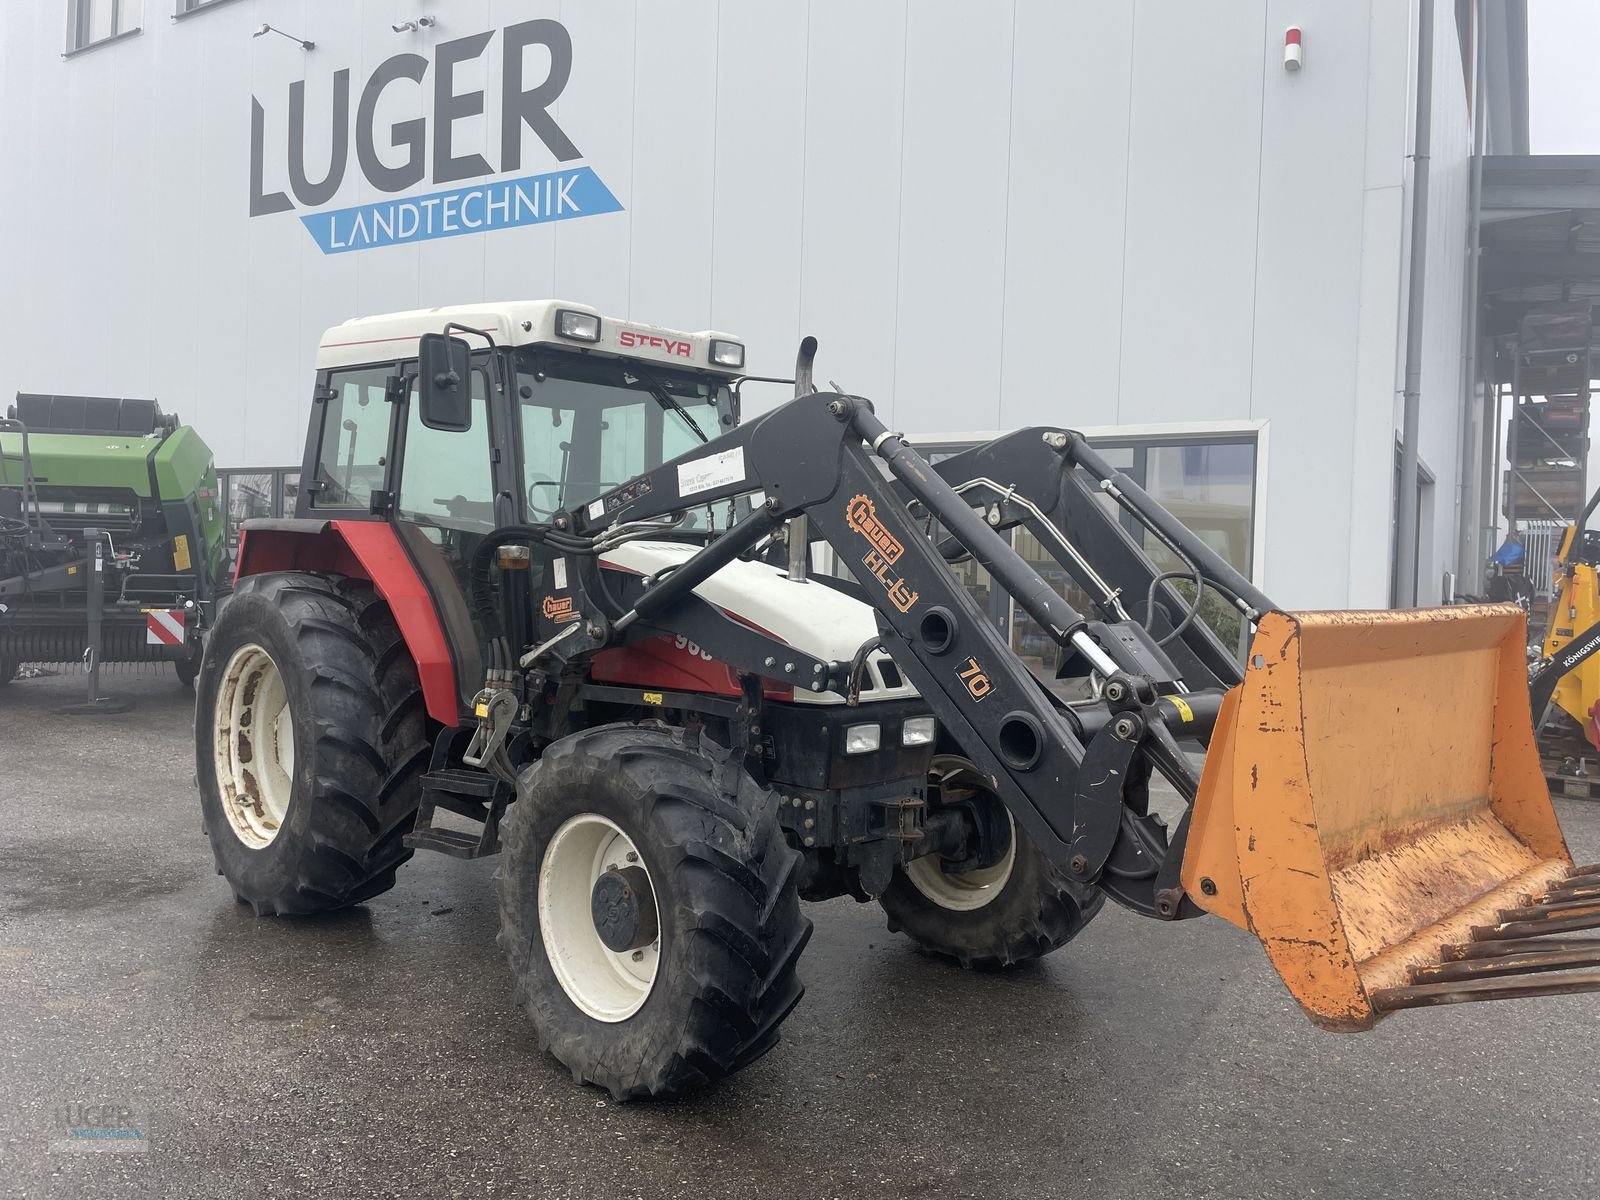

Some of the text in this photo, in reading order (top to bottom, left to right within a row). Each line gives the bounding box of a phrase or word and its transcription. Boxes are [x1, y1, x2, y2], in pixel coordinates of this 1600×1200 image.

[249, 18, 585, 218] LUGER
[330, 174, 580, 249] LANDTECHNIK
[959, 658, 991, 697] 70
